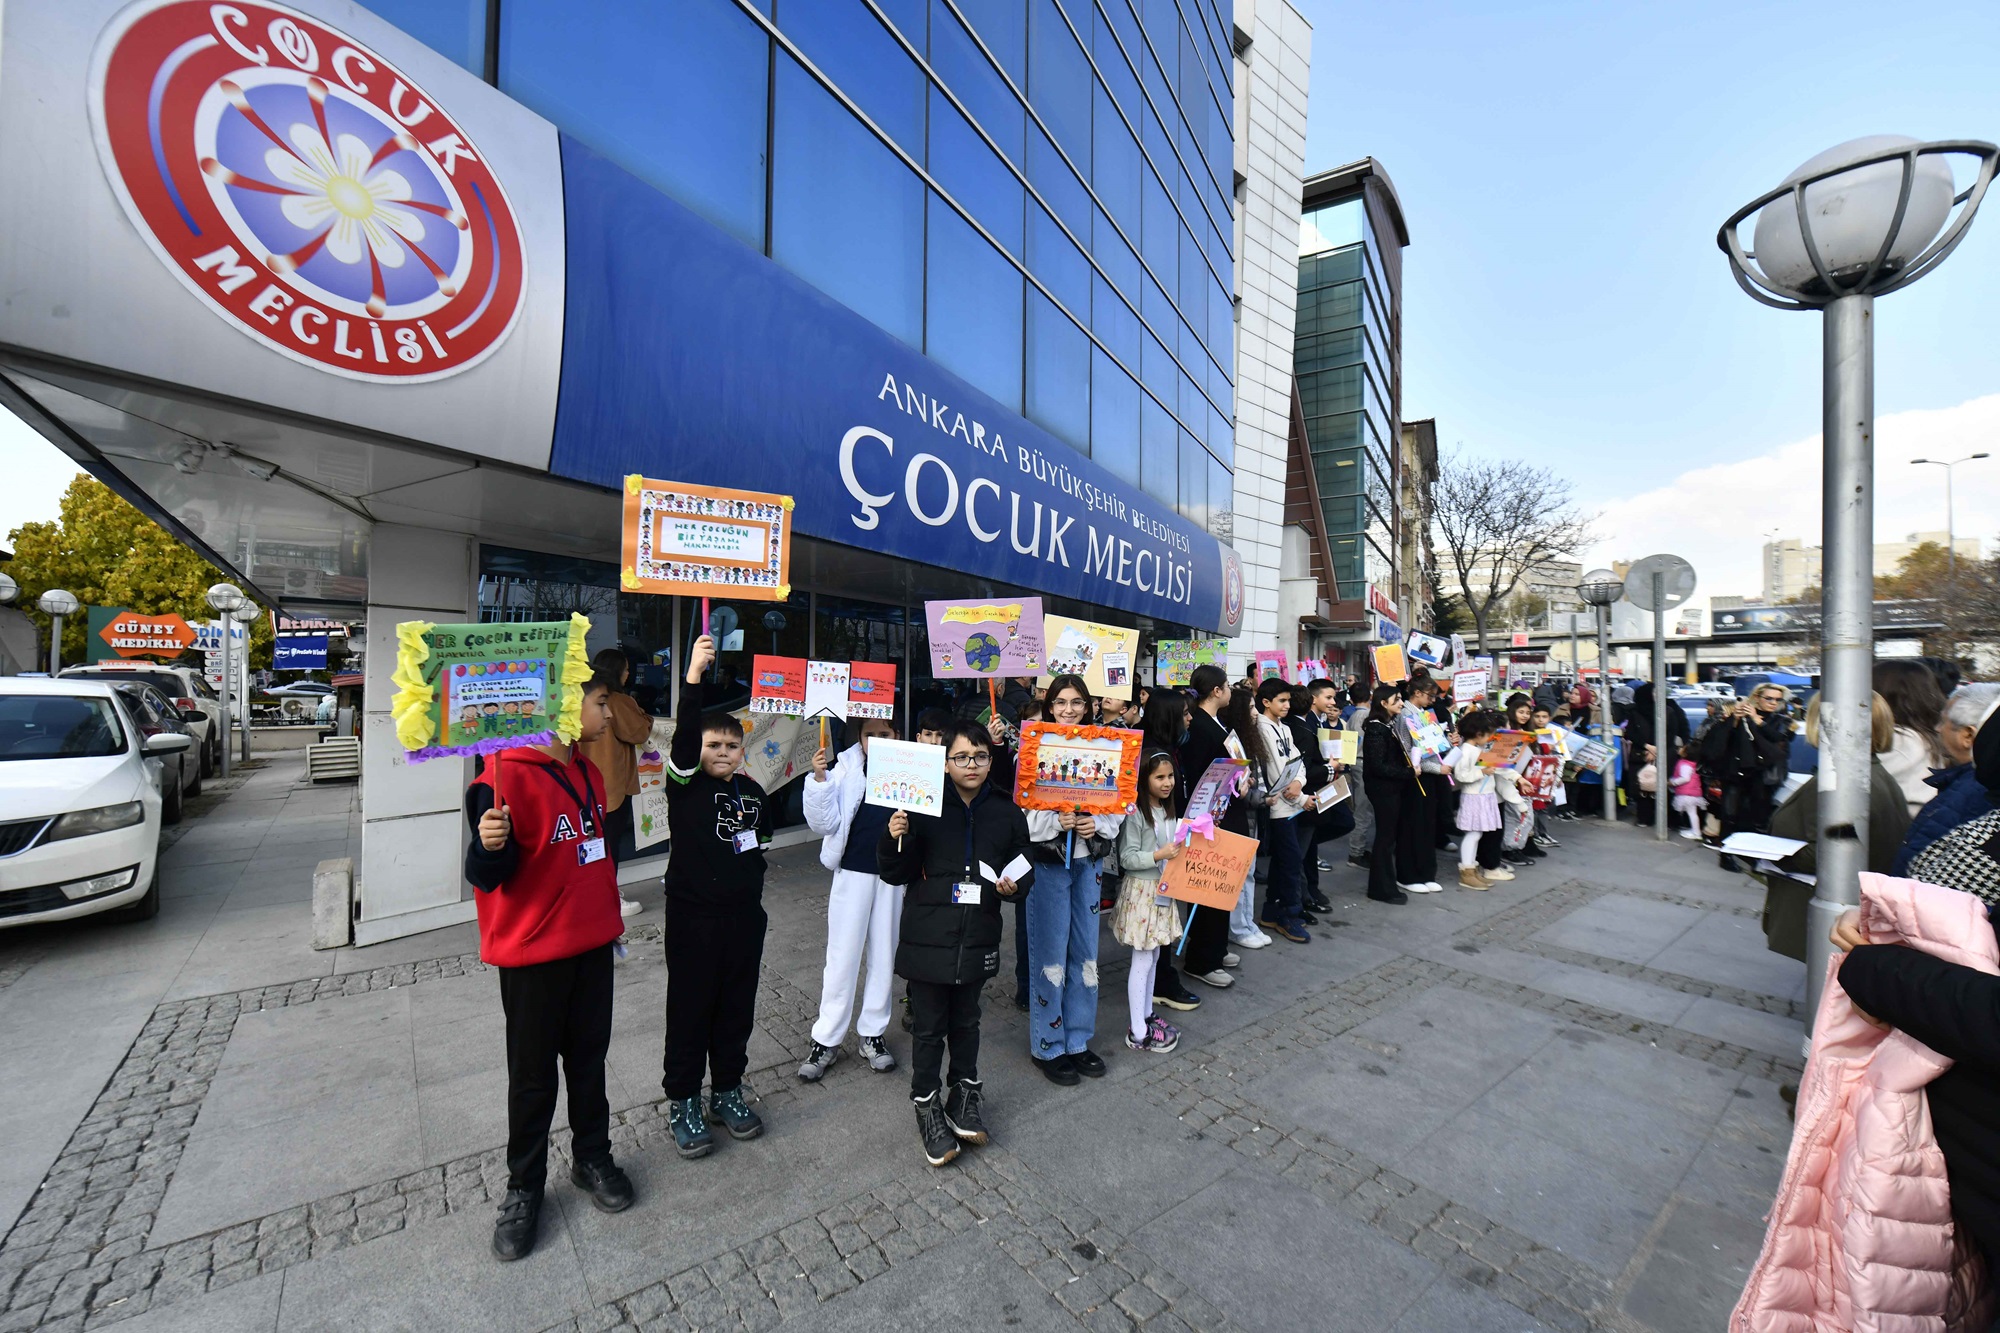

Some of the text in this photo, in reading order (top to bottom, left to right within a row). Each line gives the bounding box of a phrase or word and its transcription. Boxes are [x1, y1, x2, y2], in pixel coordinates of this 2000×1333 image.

[210, 3, 478, 177] ÇOCUK
[193, 244, 449, 365] MECLİSİ
[878, 372, 1191, 555] ANKARA BÜYÜKŞEHİR BELEDİYESİ
[838, 425, 1192, 606] ÇOCUK MECLİSİ
[678, 532, 695, 541] BİR
[702, 524, 748, 538] ÇOCUĞUN
[114, 620, 176, 635] GÜNEY
[111, 636, 183, 649] MEDİKAL
[421, 627, 567, 650] HER ÇOCUK EĞİTİM
[1158, 650, 1196, 662] ÇOCUK
